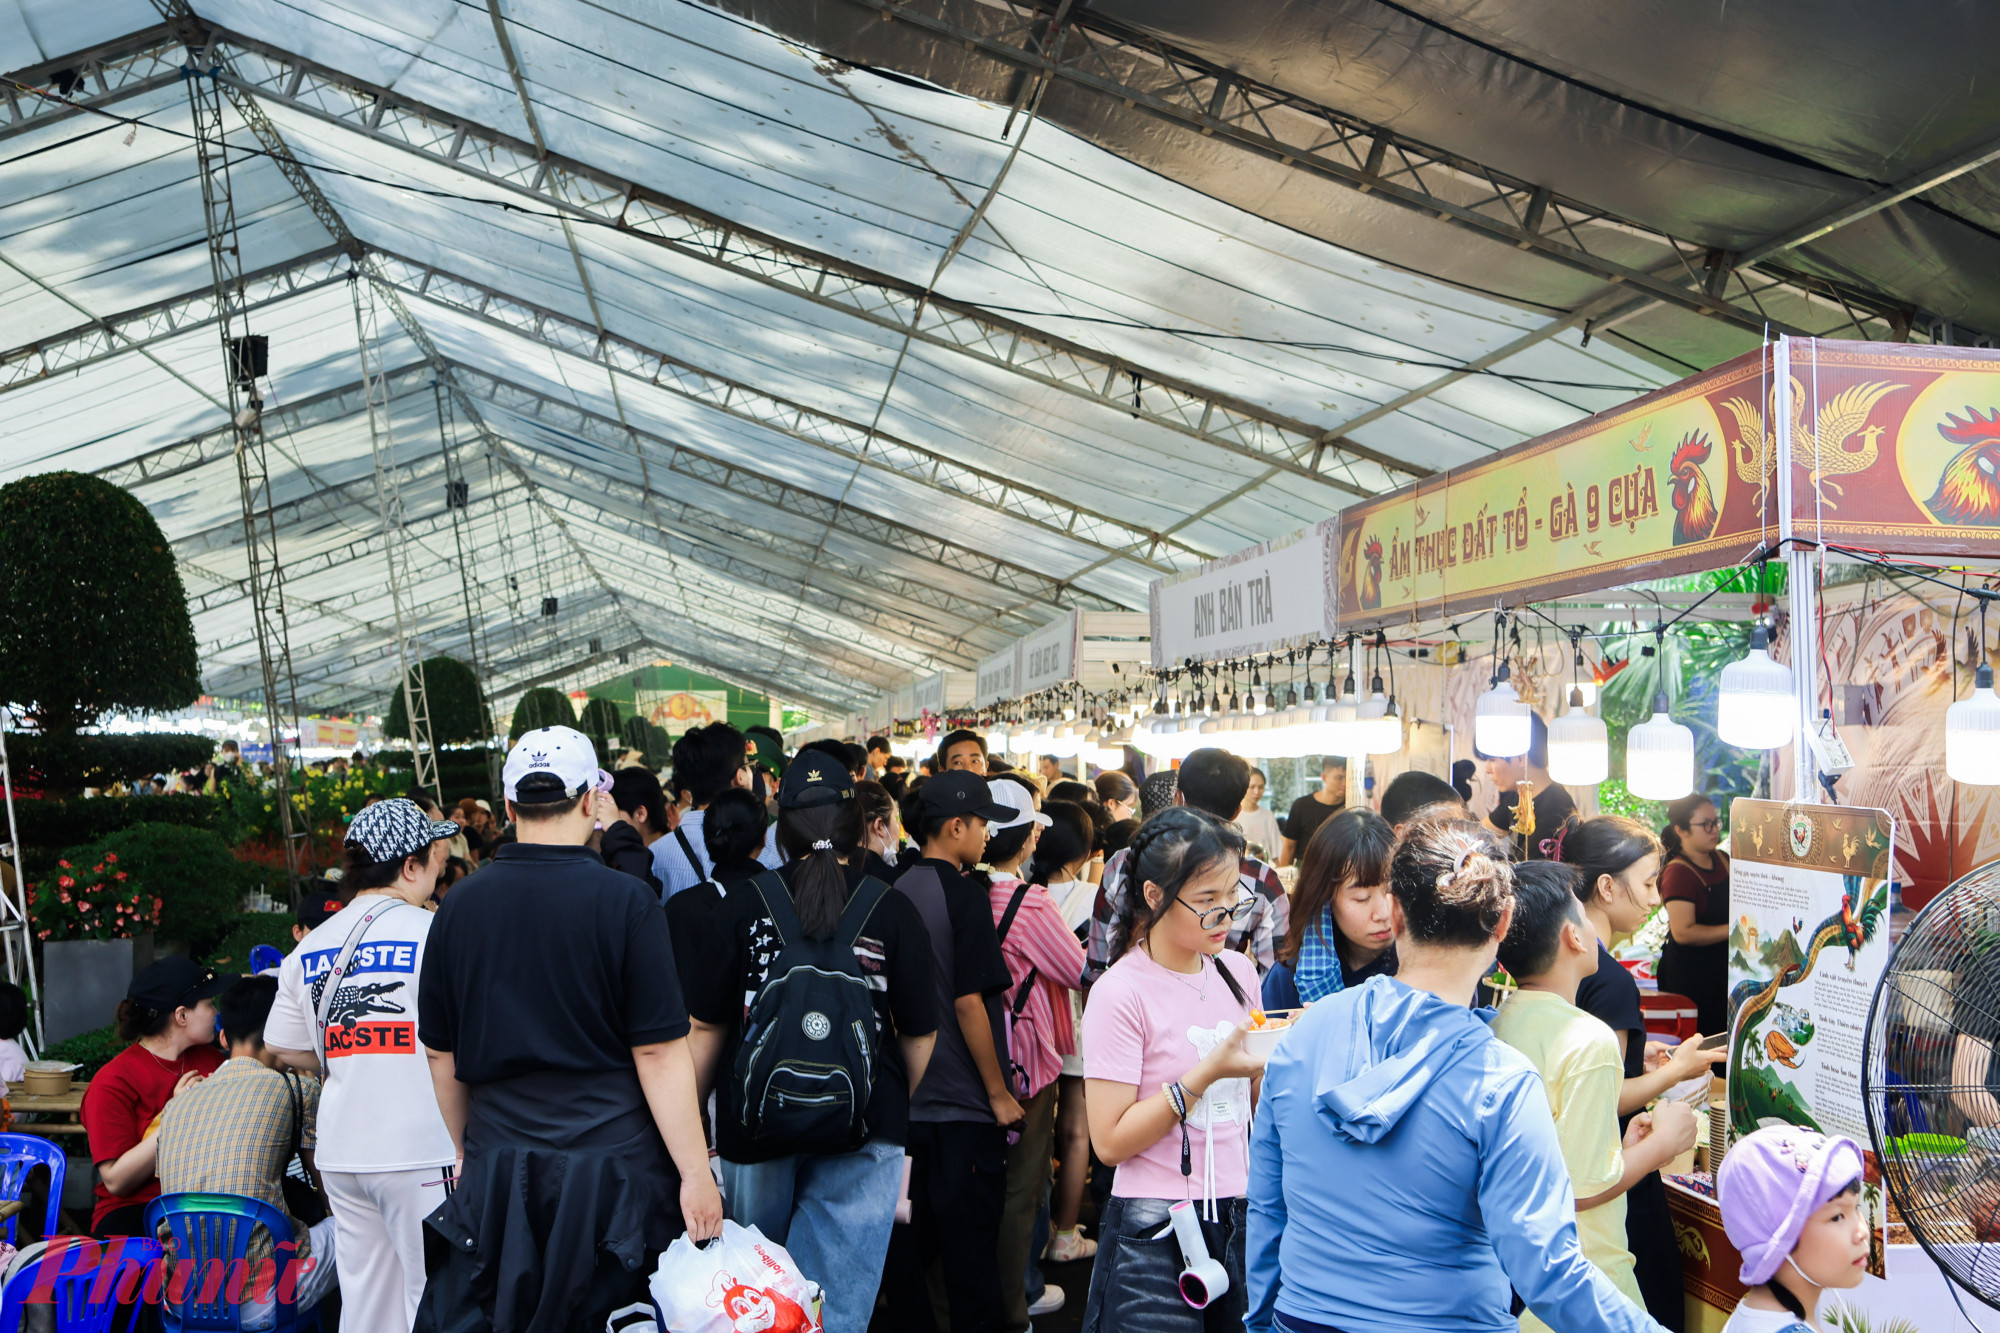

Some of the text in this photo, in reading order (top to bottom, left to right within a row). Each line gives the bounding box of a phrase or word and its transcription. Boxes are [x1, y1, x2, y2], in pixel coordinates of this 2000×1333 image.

[1389, 526, 1412, 581] ẨM
[1462, 502, 1498, 564] ĐẤT
[1503, 485, 1528, 551] TỔ
[1550, 482, 1580, 541] GÀ
[1586, 484, 1601, 532] 9
[1608, 463, 1659, 533] CỰA
[1194, 569, 1274, 639] ANH BÁN TRÀ
[754, 1244, 785, 1275] Jollibee
